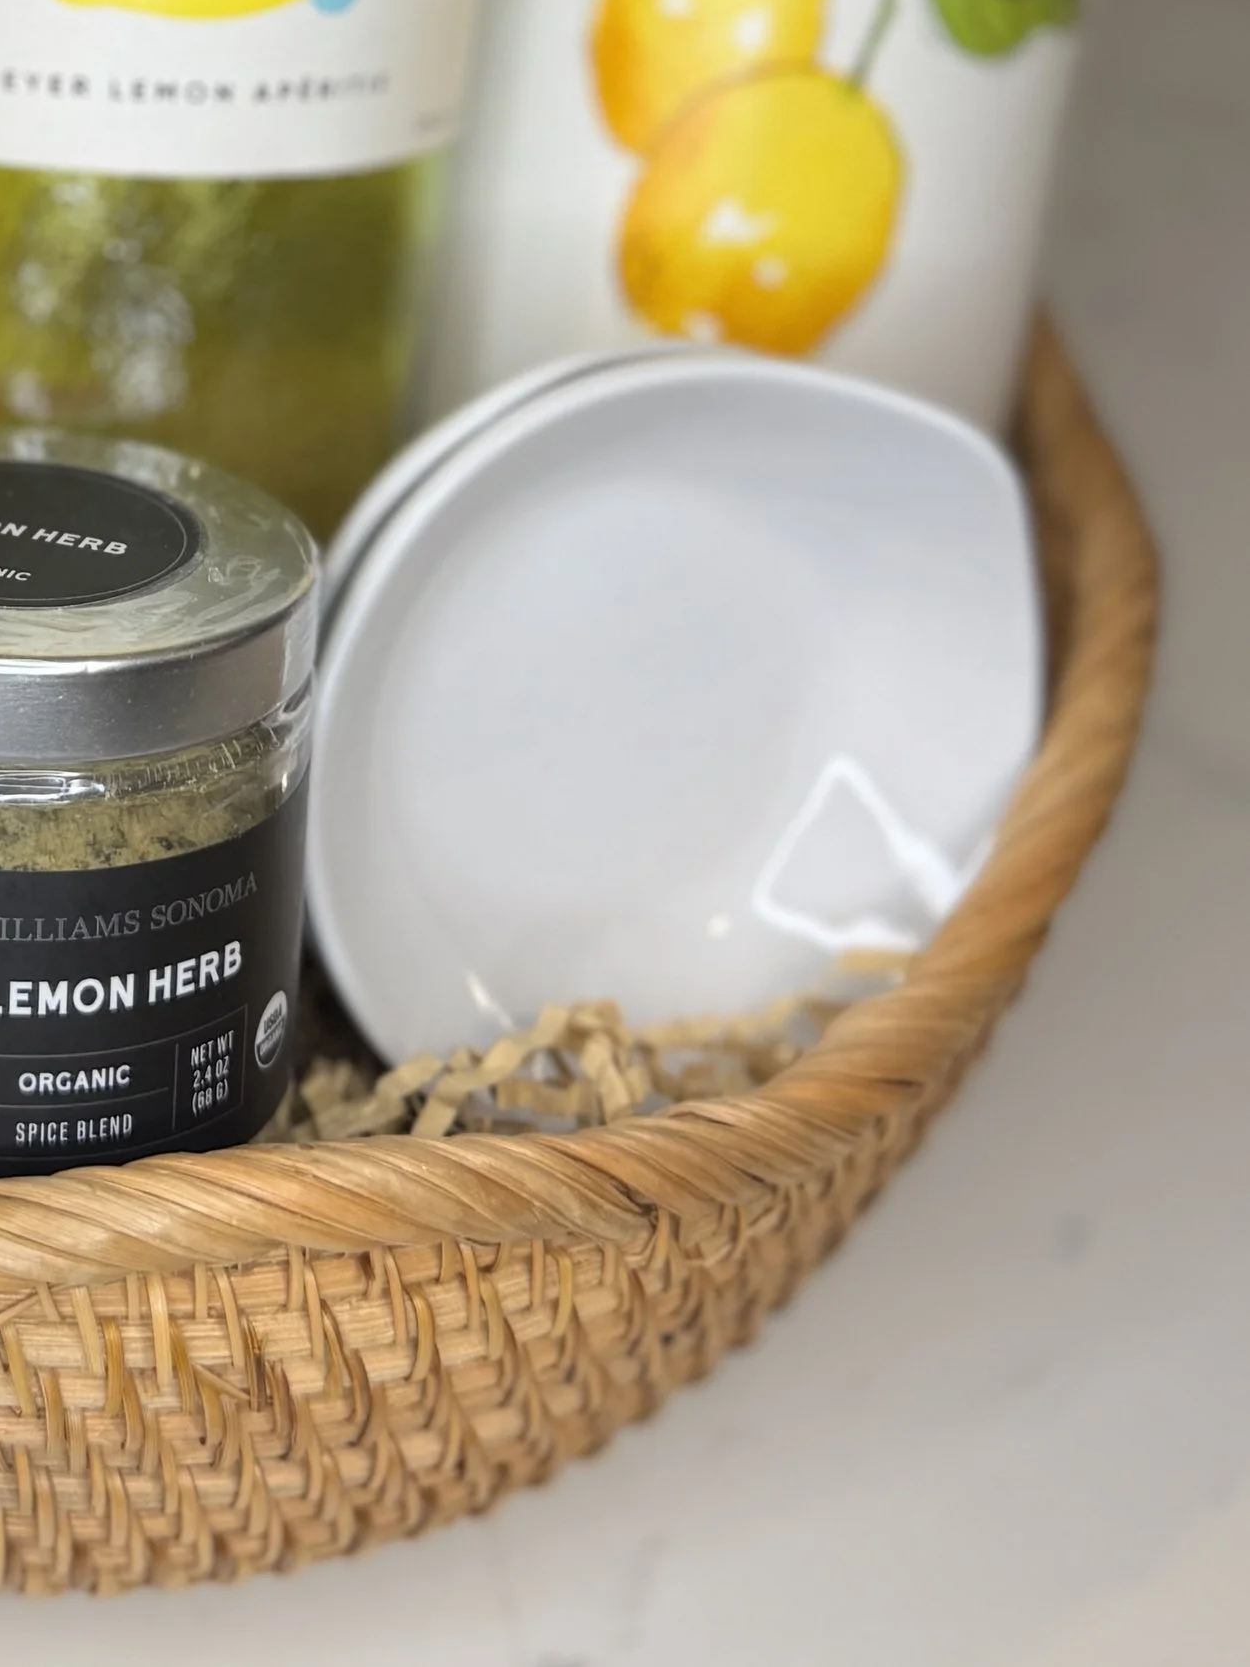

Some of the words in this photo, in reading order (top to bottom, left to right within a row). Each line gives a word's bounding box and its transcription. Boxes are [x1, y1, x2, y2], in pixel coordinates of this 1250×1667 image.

[107, 76, 236, 107] LEMON
[32, 528, 128, 555] HERB
[150, 872, 258, 931] SONOMA
[148, 940, 242, 1003] HERB
[191, 1040, 214, 1067] NET
[217, 1030, 234, 1054] WT
[18, 1064, 131, 1093] ORGANIC
[193, 1065, 212, 1088] 2.4
[216, 1055, 229, 1078] OZ
[192, 1087, 212, 1116] (68
[216, 1078, 229, 1101] G)
[15, 1121, 69, 1143] SPICE
[76, 1113, 133, 1140] BLEND
